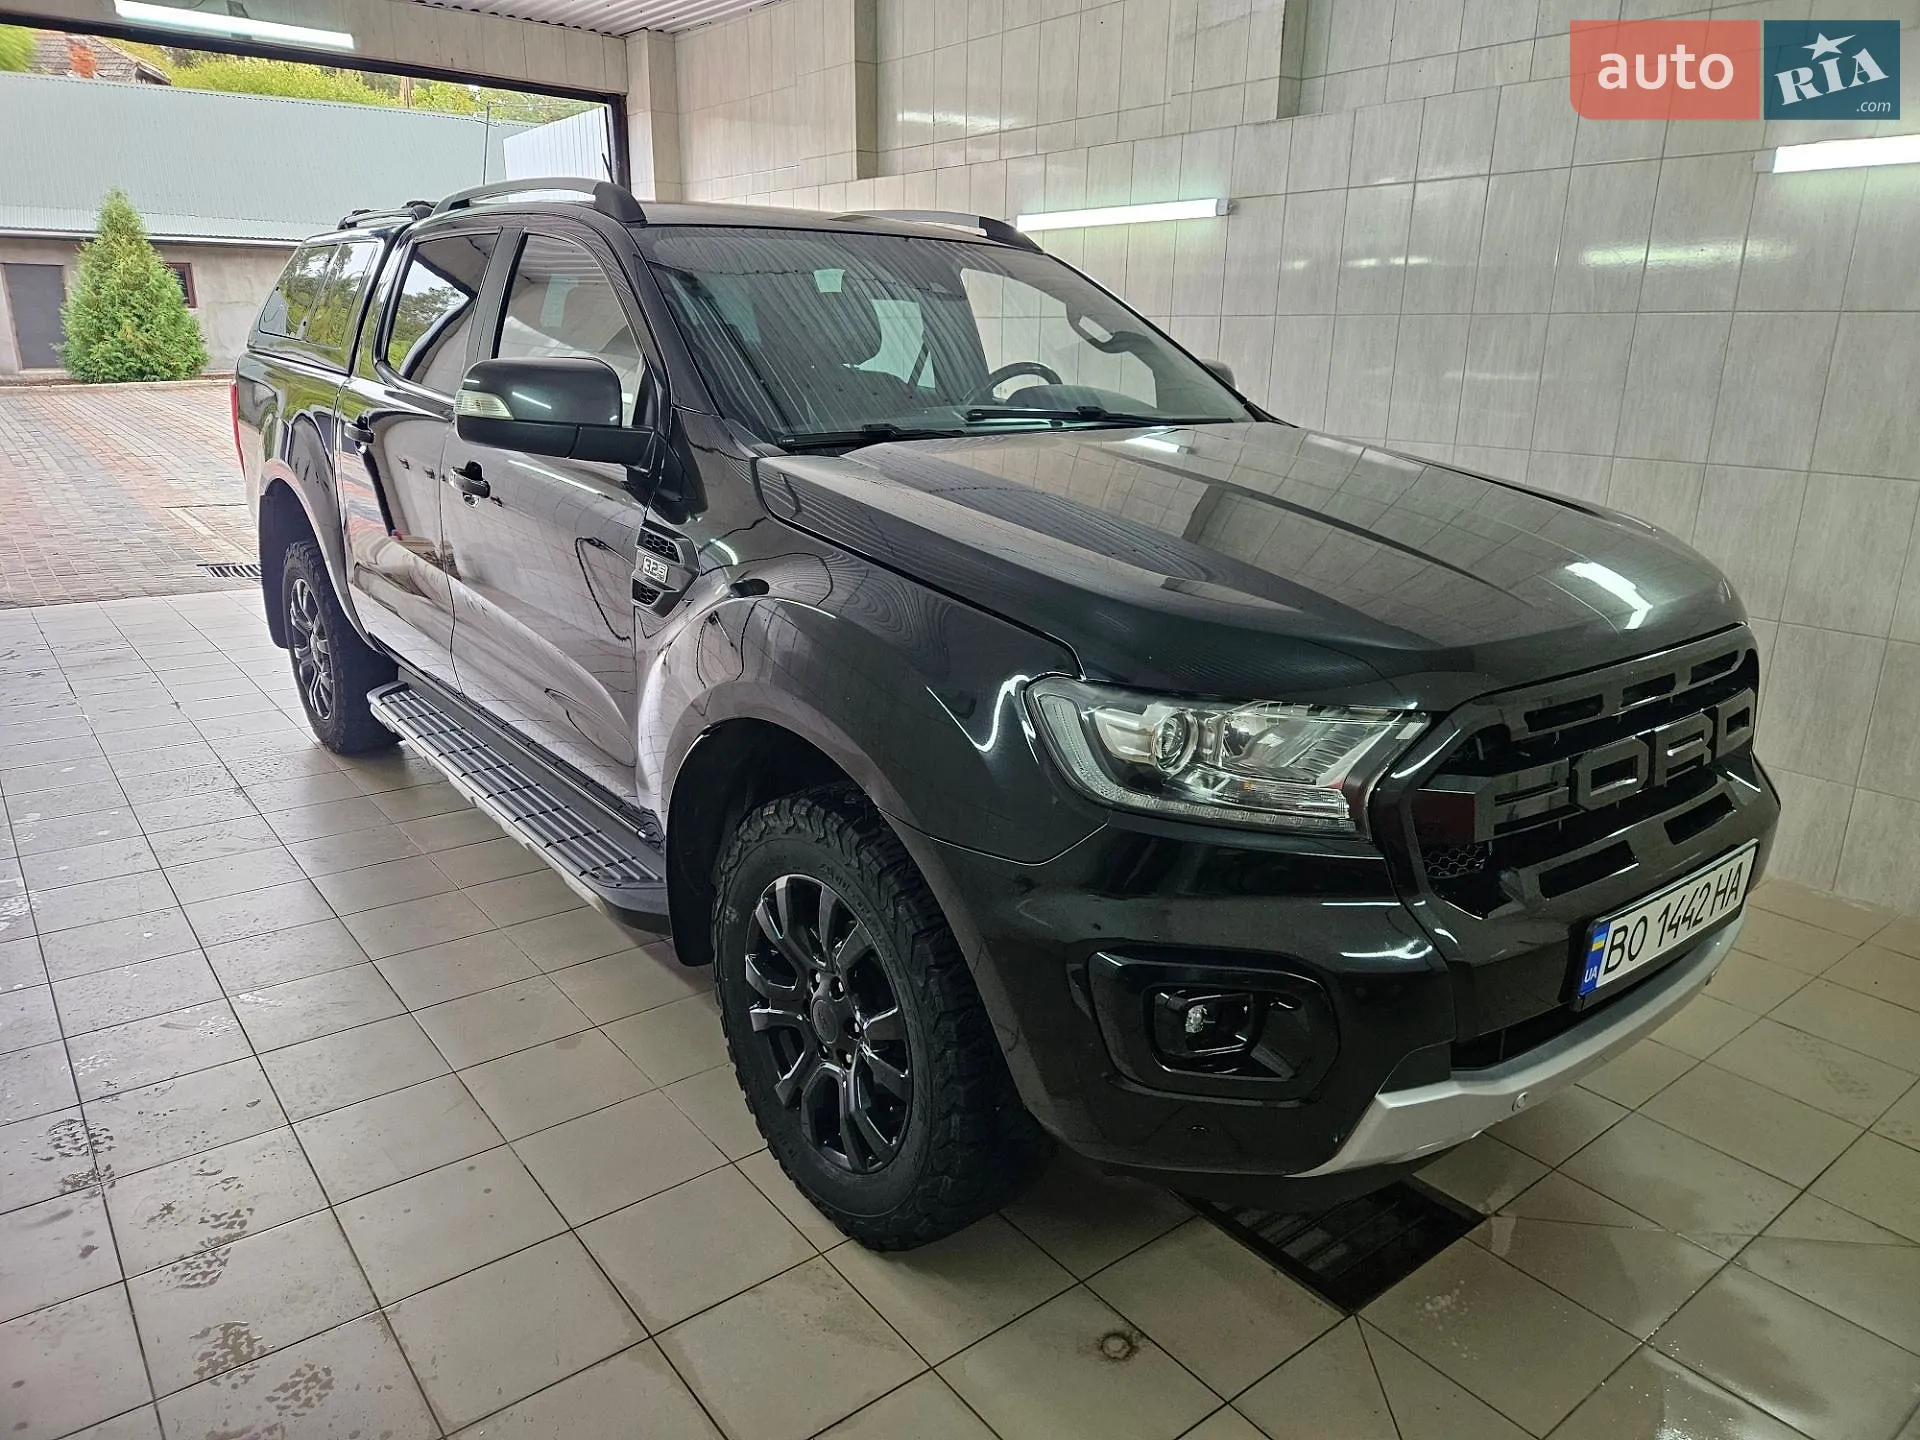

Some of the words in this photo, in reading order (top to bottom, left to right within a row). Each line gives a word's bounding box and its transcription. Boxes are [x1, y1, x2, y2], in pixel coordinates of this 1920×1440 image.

[1474, 688, 1756, 843] FORD
[1584, 965, 1599, 984] UA
[1603, 915, 1648, 976] BO
[1657, 881, 1711, 948] 1442
[1709, 861, 1744, 917] HA
